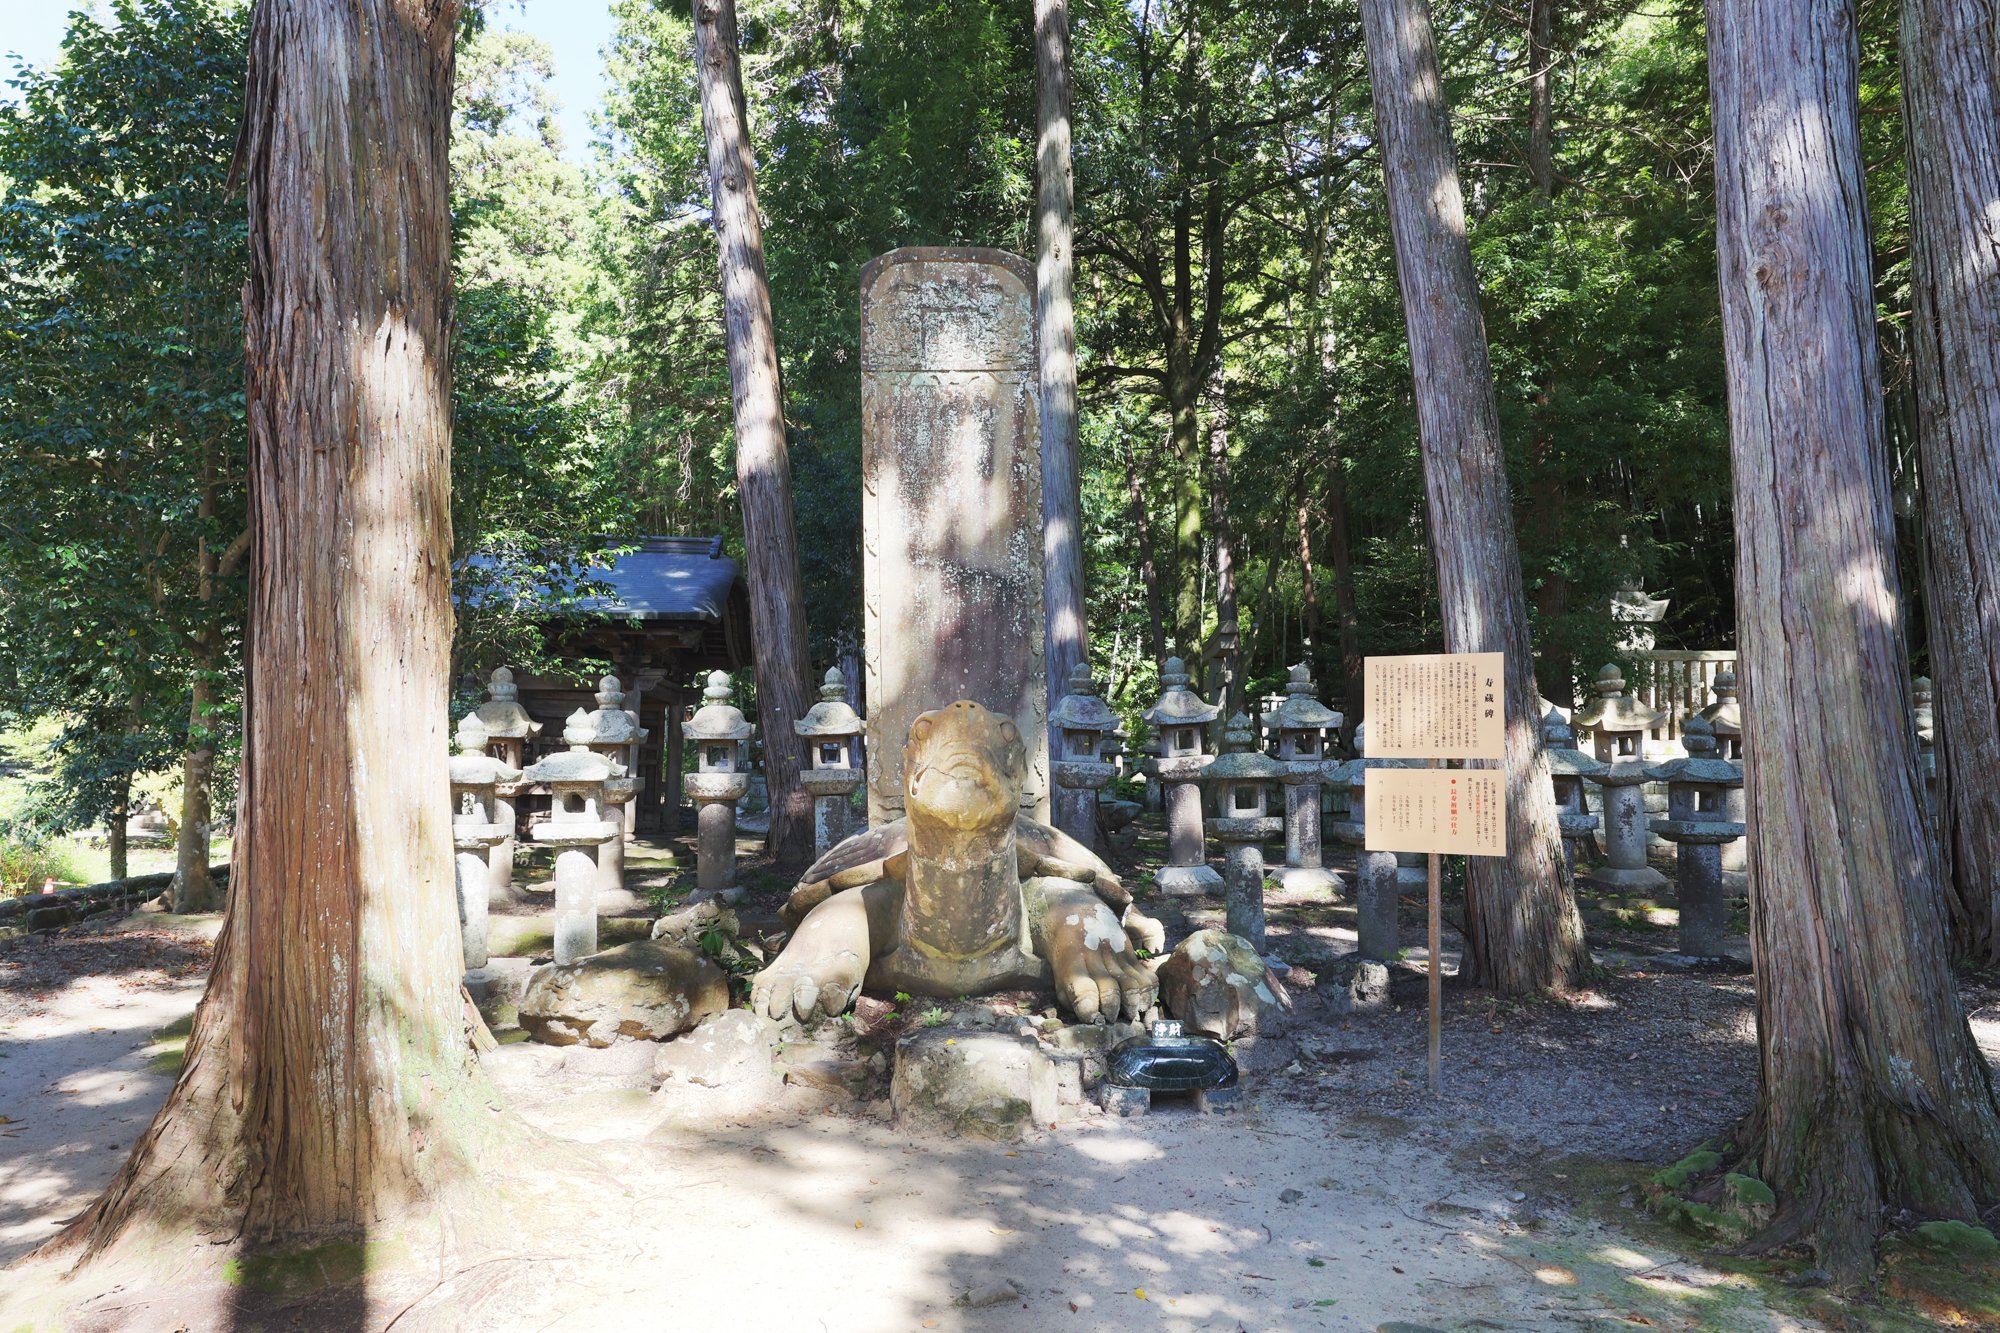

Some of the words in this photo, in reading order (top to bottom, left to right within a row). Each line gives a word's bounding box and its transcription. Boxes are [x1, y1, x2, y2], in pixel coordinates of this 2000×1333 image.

[1484, 677, 1494, 719] 寿蔵碑
[1450, 788, 1458, 836] 長寿祈願の仕方
[1154, 1022, 1182, 1037] 浄財
